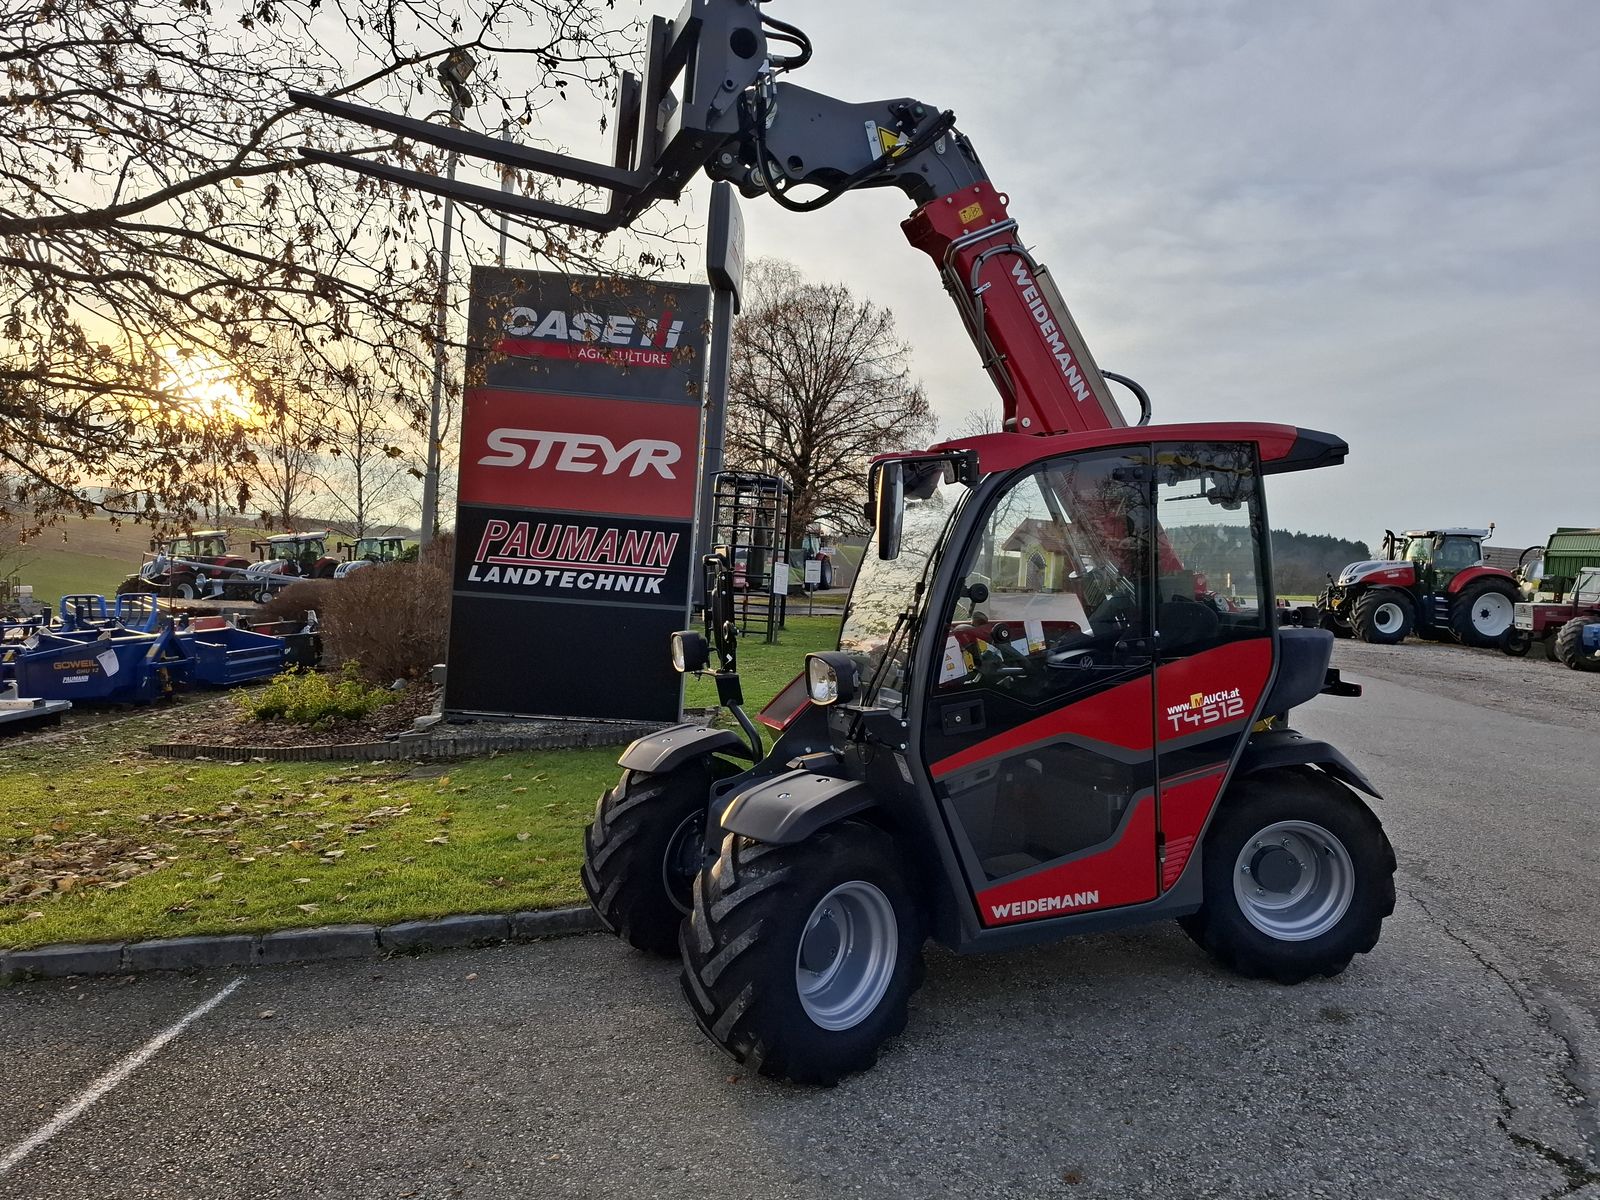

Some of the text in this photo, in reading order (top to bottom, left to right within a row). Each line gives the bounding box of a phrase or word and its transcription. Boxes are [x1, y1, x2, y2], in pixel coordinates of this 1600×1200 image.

[503, 306, 635, 345] CASE
[1012, 259, 1090, 402] WEIDEMANN
[578, 347, 668, 365] AGRCULTURE
[477, 428, 682, 480] STEYR
[474, 519, 680, 568] PAUMANN
[468, 565, 665, 594] LANDTECHNIK
[1167, 687, 1240, 715] www.MAUCH.at
[1167, 697, 1245, 732] T4512
[991, 890, 1099, 919] WEIDEMANN
